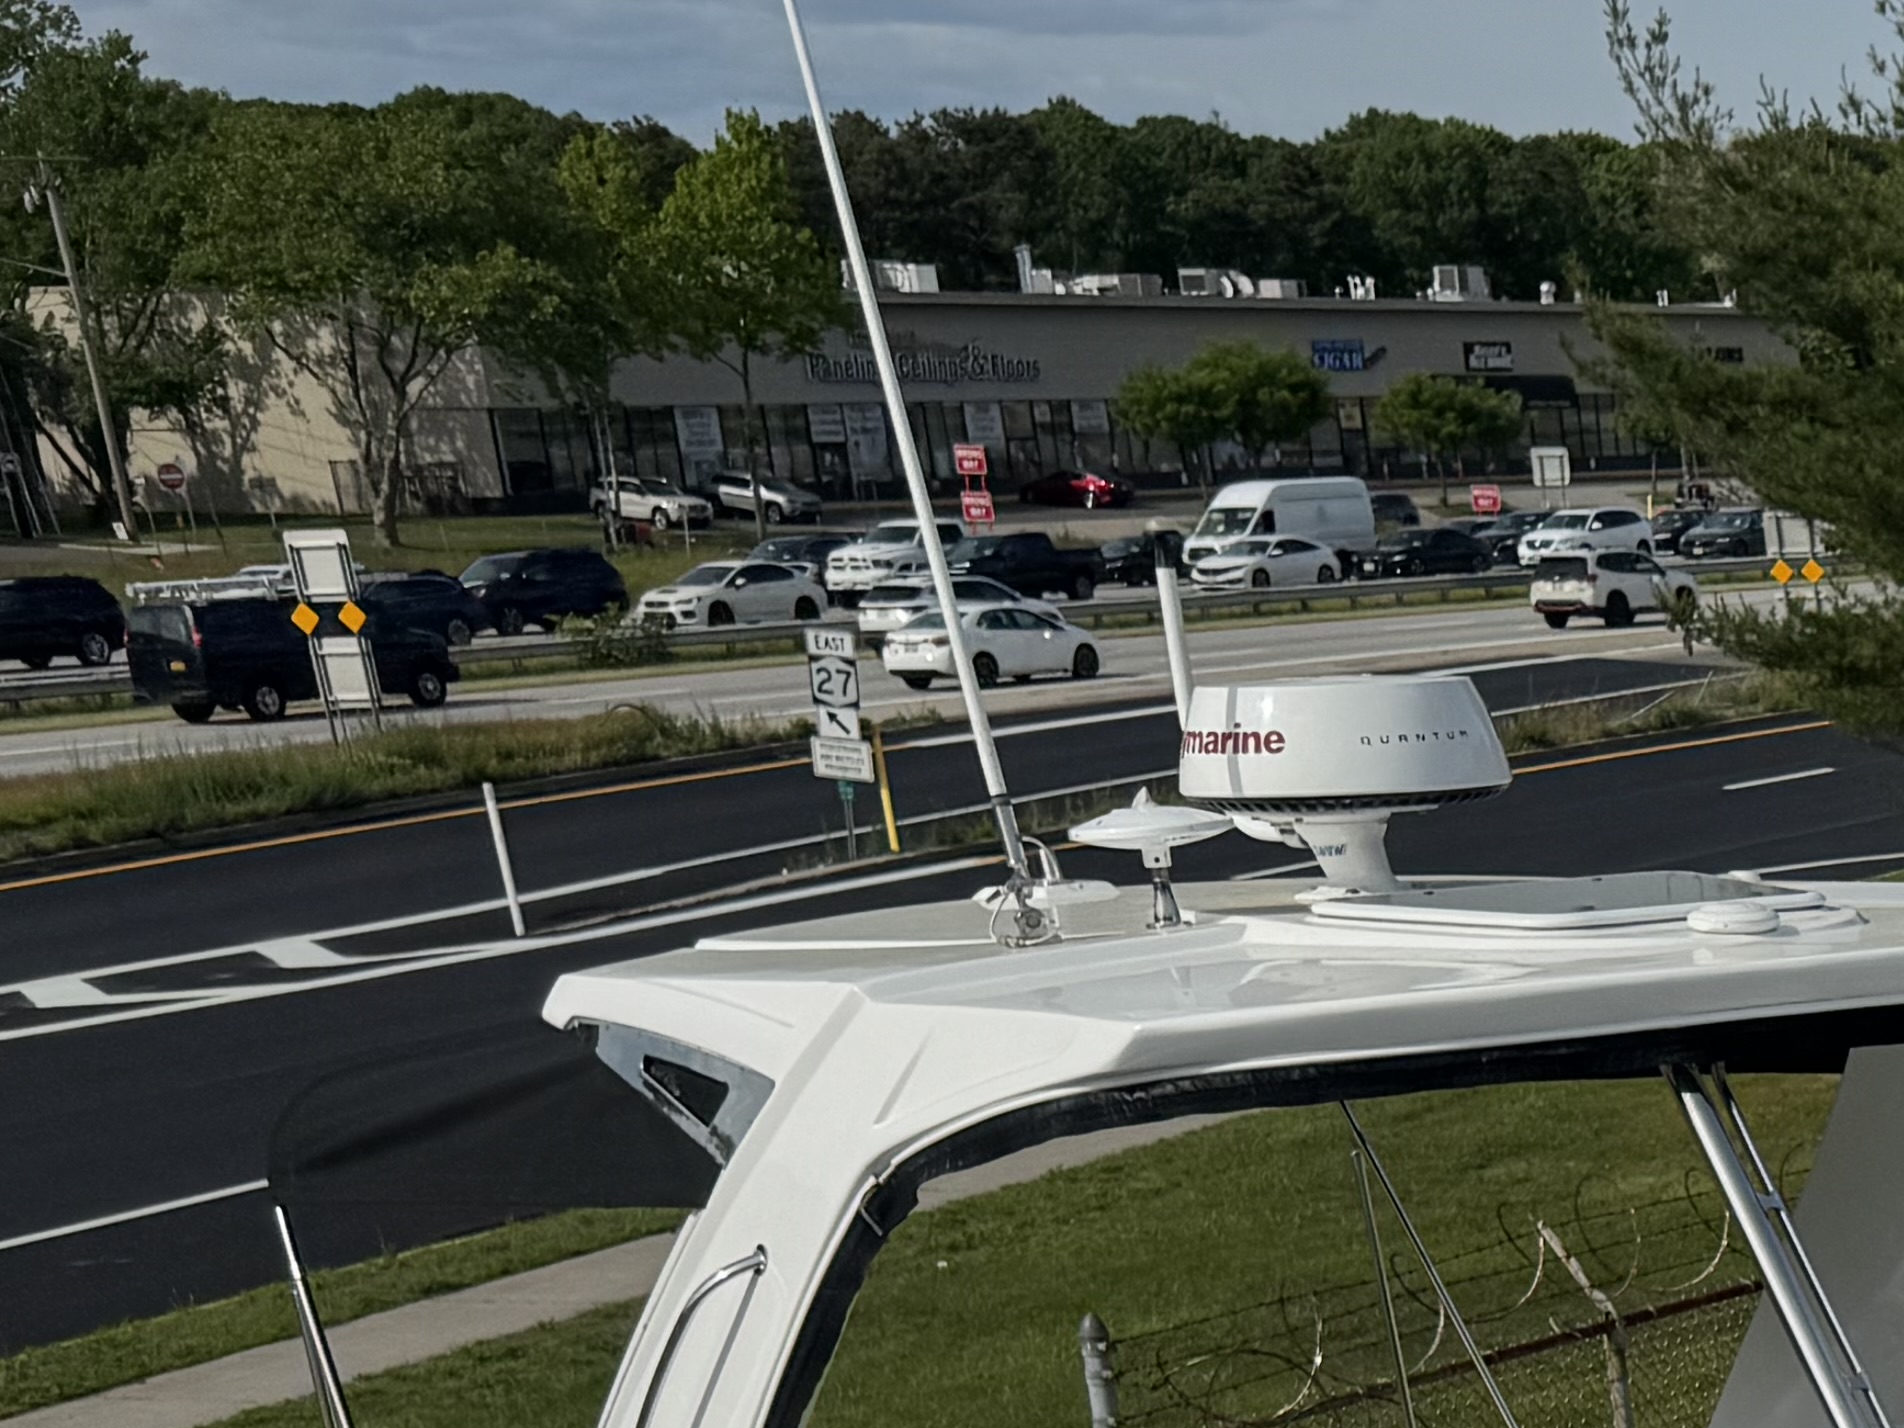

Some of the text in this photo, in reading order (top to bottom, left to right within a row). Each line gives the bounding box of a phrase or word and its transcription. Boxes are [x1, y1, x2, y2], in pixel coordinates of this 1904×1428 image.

[806, 353, 879, 384] Panelin
[894, 352, 968, 384] Ceilings
[989, 353, 1041, 380] Floors
[814, 635, 846, 652] EAST
[816, 667, 852, 697] 27
[1360, 729, 1469, 746] QUANTUM
